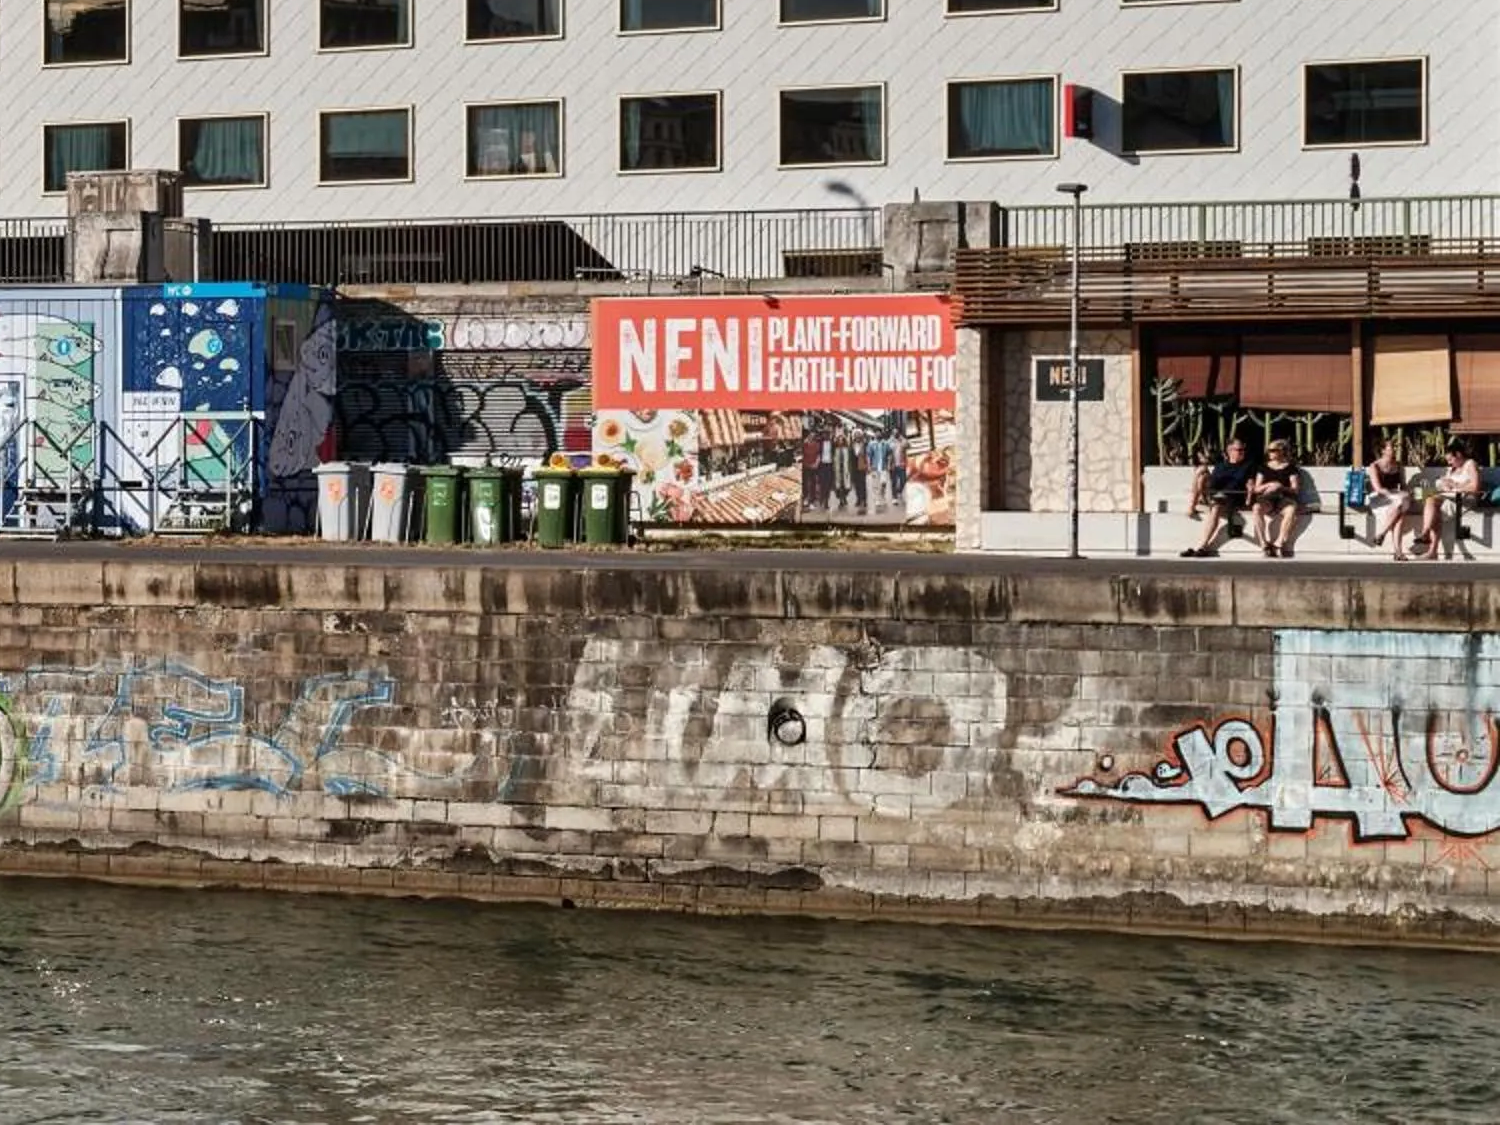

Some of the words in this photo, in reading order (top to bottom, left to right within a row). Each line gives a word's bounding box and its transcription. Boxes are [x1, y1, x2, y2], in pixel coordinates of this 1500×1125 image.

[768, 315, 941, 353] PLANT-FORWARD
[619, 318, 763, 392] NENI
[768, 357, 916, 393] EARTH-LOVING
